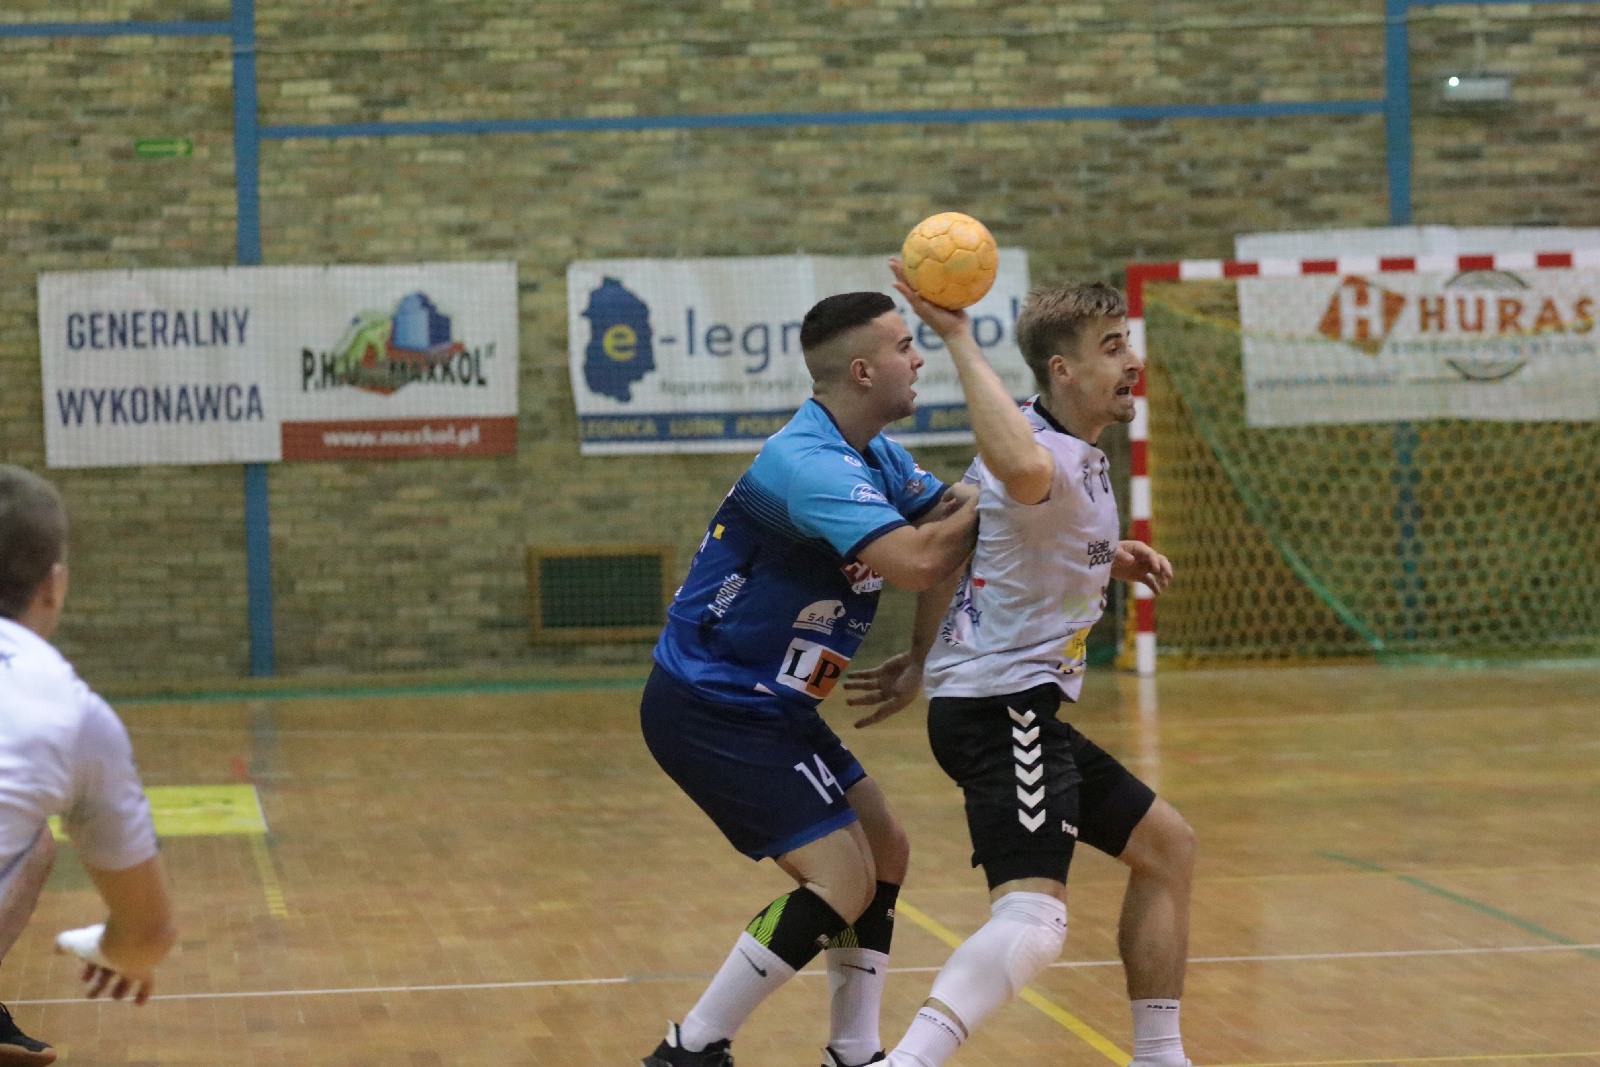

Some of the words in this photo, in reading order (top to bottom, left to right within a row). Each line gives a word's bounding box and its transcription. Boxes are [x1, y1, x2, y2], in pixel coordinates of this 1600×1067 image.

[66, 307, 250, 350] GENERALNY
[1418, 297, 1594, 335] HURAS
[57, 384, 265, 427] WYKONAWCA
[794, 753, 845, 805] 14
